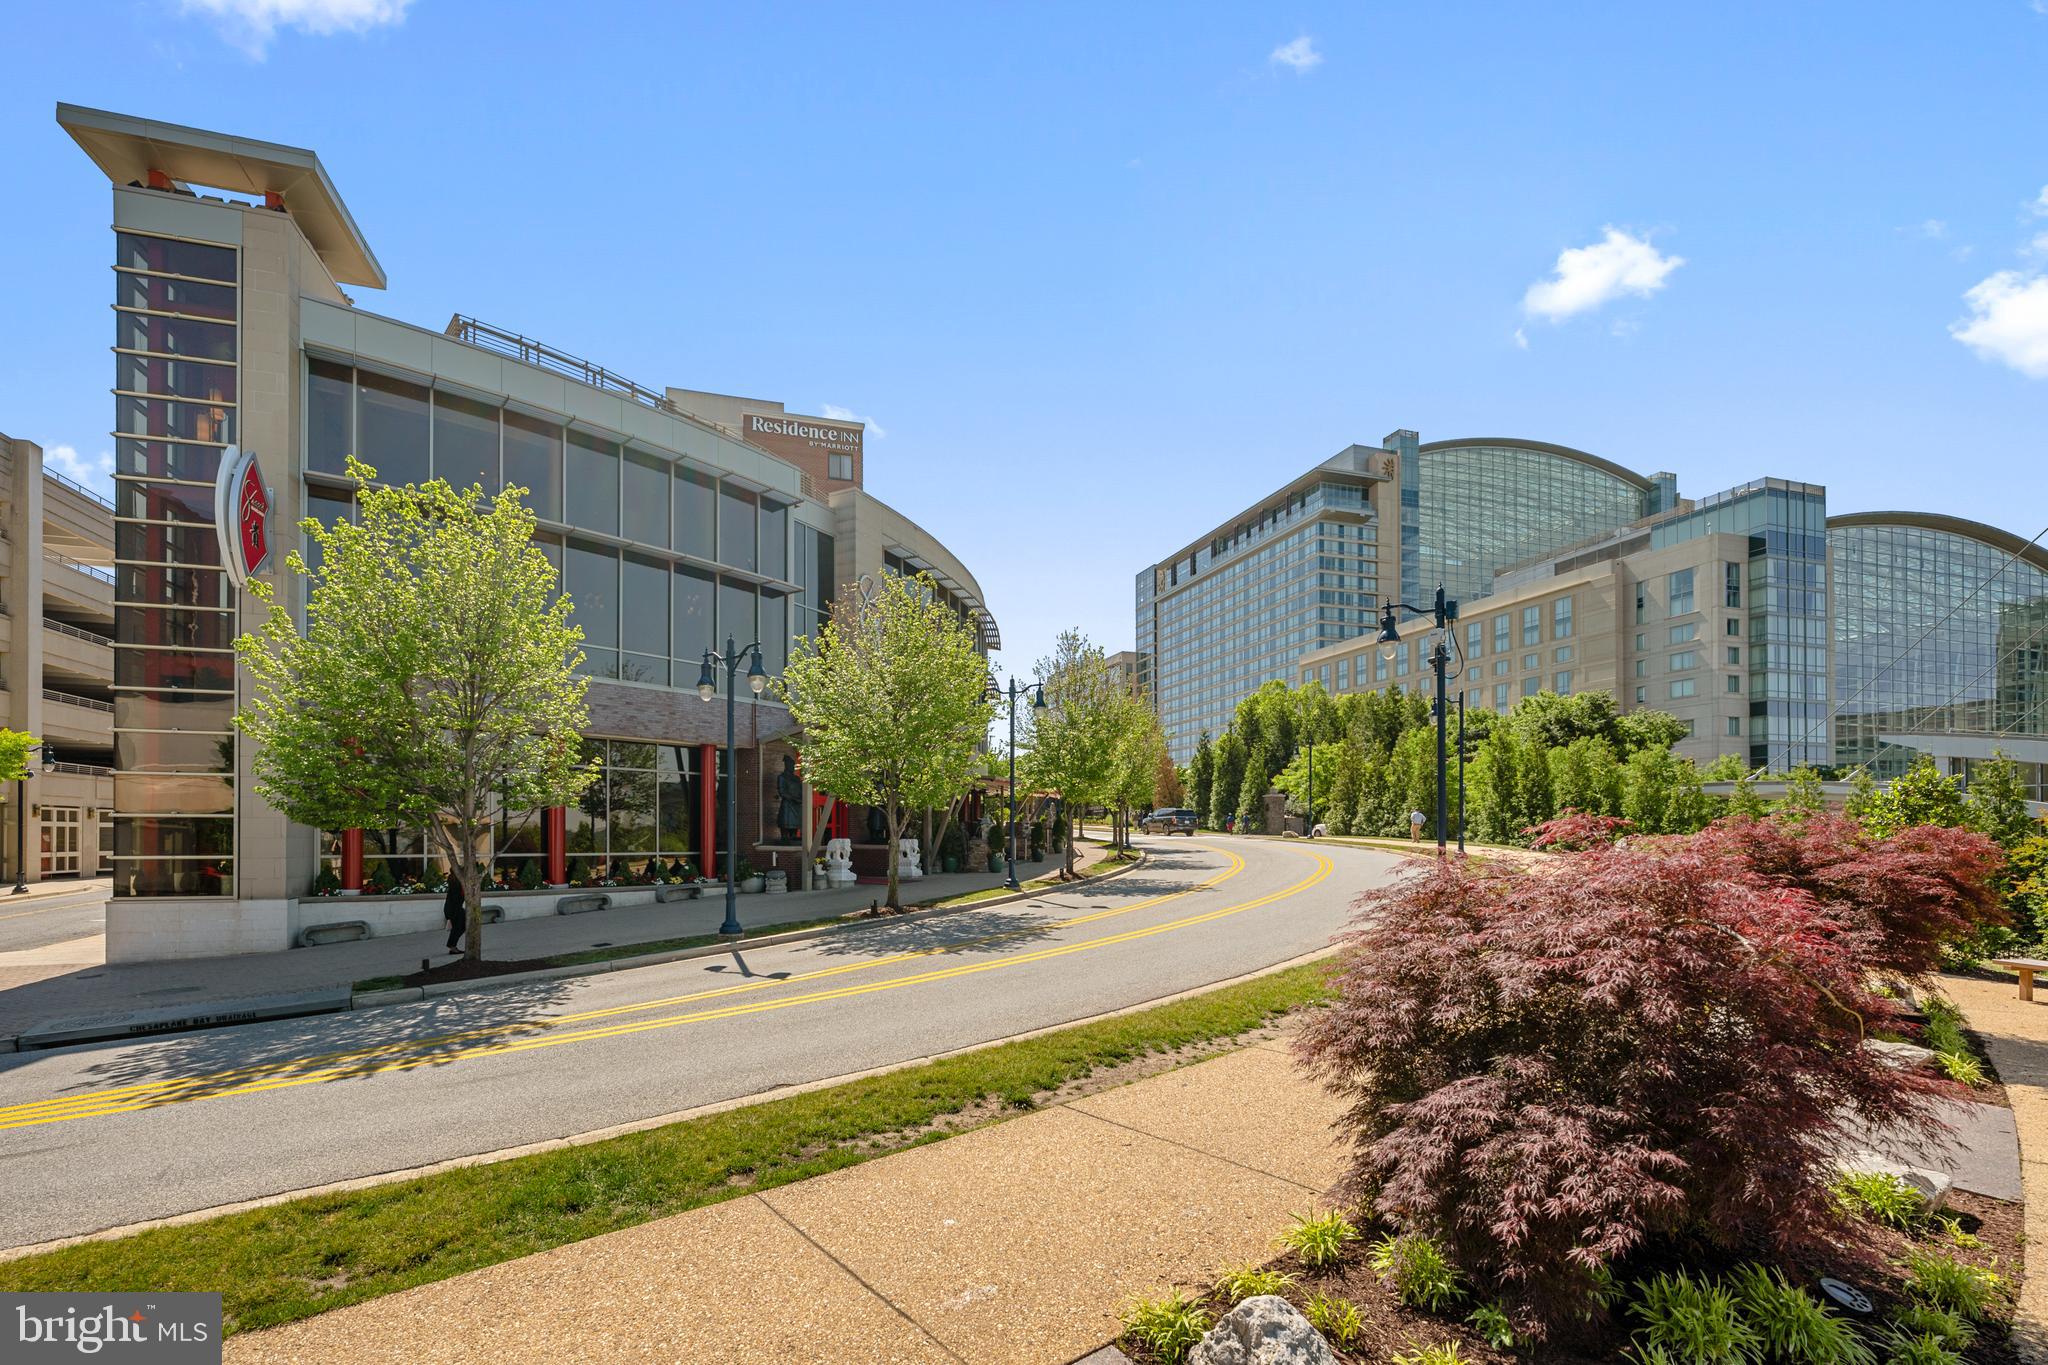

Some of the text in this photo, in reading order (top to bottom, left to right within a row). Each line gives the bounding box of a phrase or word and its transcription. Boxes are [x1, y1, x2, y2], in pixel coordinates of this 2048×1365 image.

[752, 416, 859, 443] Residence INN
[821, 441, 859, 451] MARRIOTT
[193, 1016, 211, 1025] BAY
